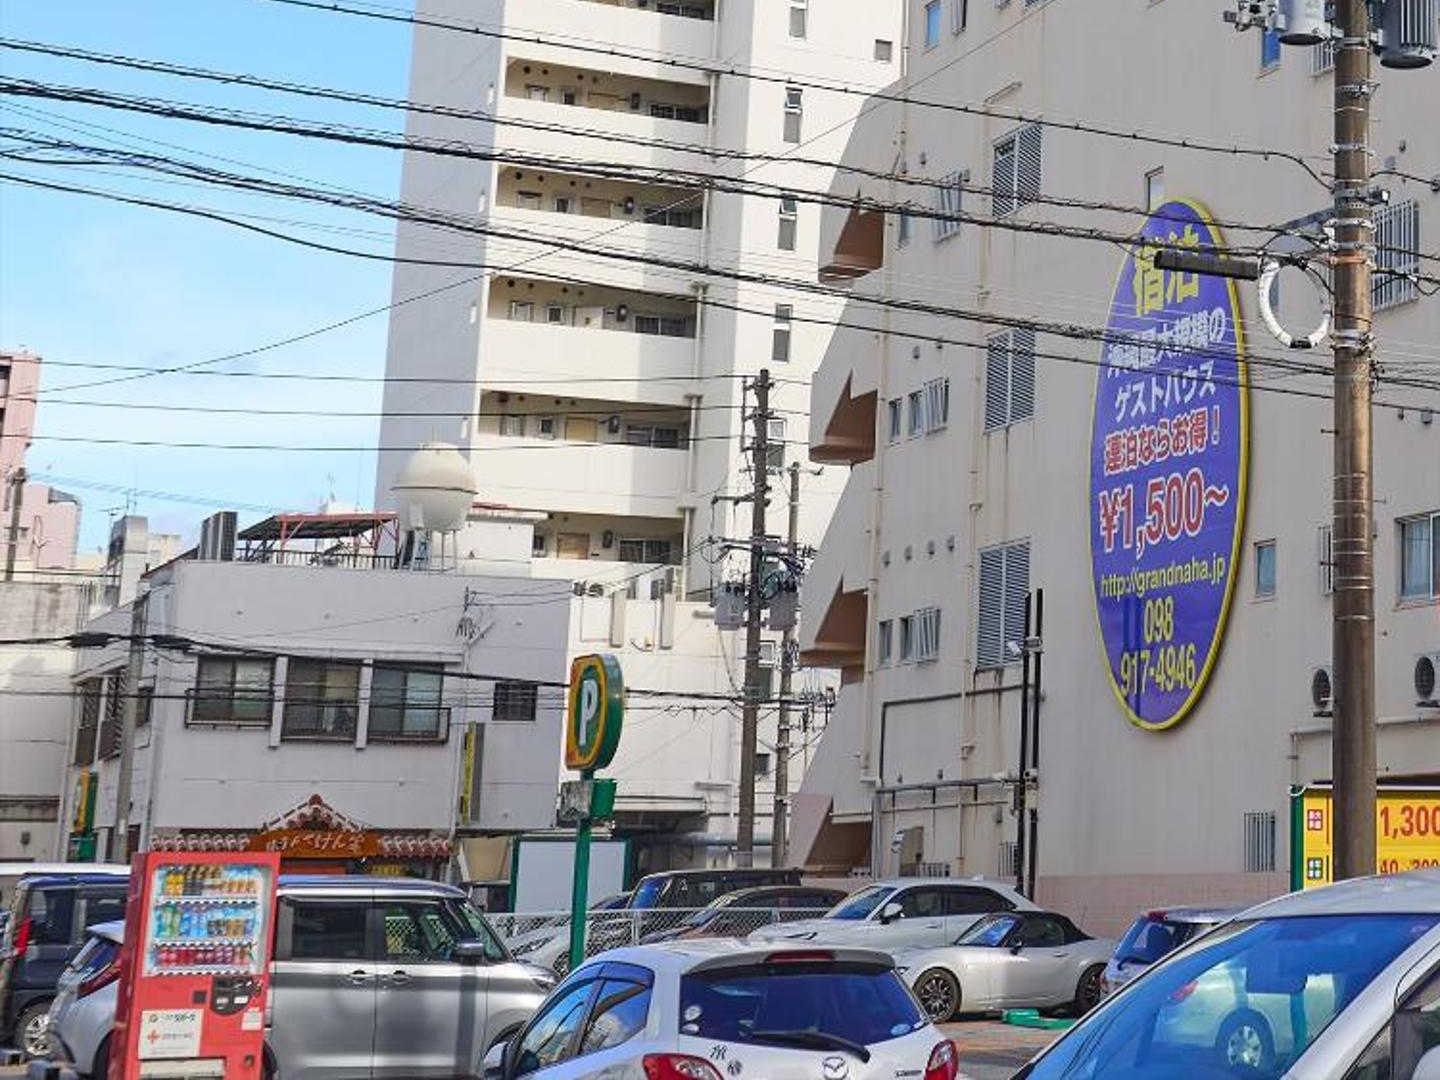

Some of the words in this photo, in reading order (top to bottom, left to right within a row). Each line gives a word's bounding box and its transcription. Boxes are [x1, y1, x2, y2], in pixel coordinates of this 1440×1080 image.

[1115, 360, 1217, 422] ゲストハウス
[1143, 595, 1175, 644] 098
[1120, 642, 1197, 698] 917-4946
[578, 678, 599, 747] P
